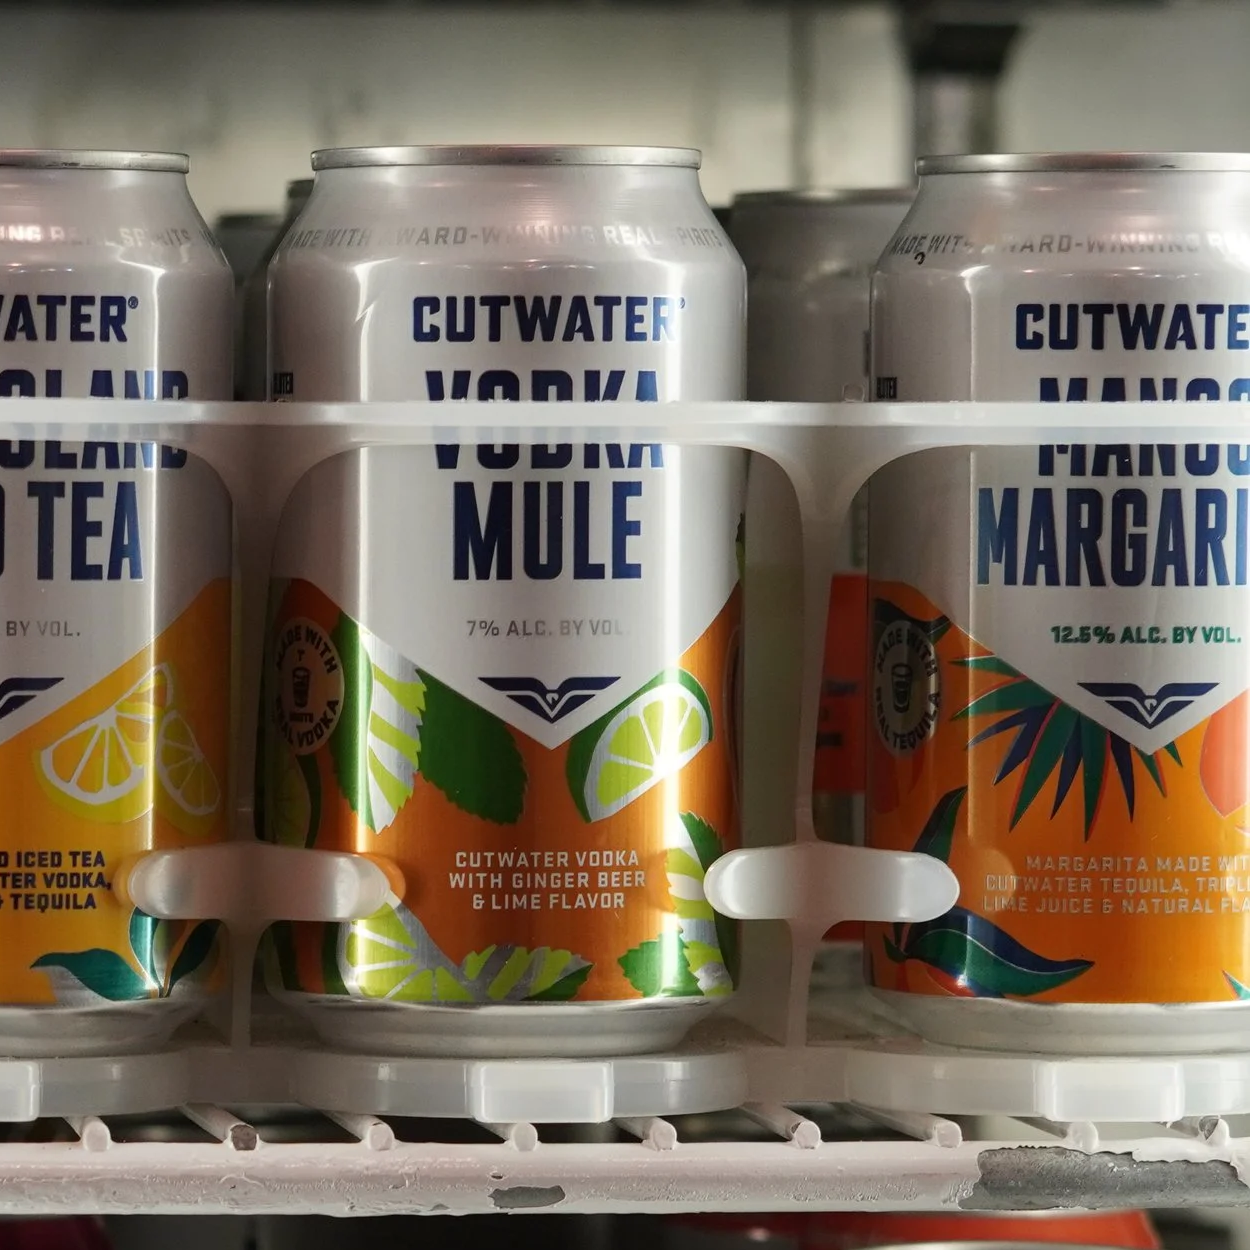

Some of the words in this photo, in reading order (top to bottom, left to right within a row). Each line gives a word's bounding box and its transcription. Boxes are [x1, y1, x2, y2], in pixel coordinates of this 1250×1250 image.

[602, 225, 662, 246] REAL
[27, 481, 144, 582] TEA
[453, 480, 643, 581] MULE
[976, 486, 1248, 587] MARGARI
[6, 620, 31, 637] BY
[36, 620, 82, 637] VOL.
[466, 619, 500, 637] 7%
[506, 620, 553, 637] ALC.
[559, 620, 584, 637] BY
[1051, 625, 1115, 644] 12.5%
[1121, 626, 1167, 645] ALC.
[1173, 627, 1198, 645] BY
[1202, 626, 1241, 645] VOL.
[305, 624, 339, 676] WITH
[296, 697, 341, 750] VODKA
[16, 851, 63, 869] ICED
[69, 851, 106, 868] TEA
[456, 851, 569, 869] CUTWATER
[575, 850, 639, 868] VODKA
[1026, 856, 1149, 873] MARGARITA
[1156, 856, 1210, 873] MADE
[42, 872, 112, 892] VODKA,
[449, 871, 501, 889] WITH
[512, 872, 589, 890] GINGER
[598, 870, 646, 889] BEER
[986, 874, 1092, 893] CUTWATER
[12, 893, 97, 914] TEQUILA
[472, 892, 485, 911] &
[491, 893, 541, 910] LIME
[549, 892, 625, 909] FLAVOR
[982, 895, 1029, 913] LIME
[1036, 896, 1093, 914] JUICE
[1121, 897, 1214, 915] NATURAL
